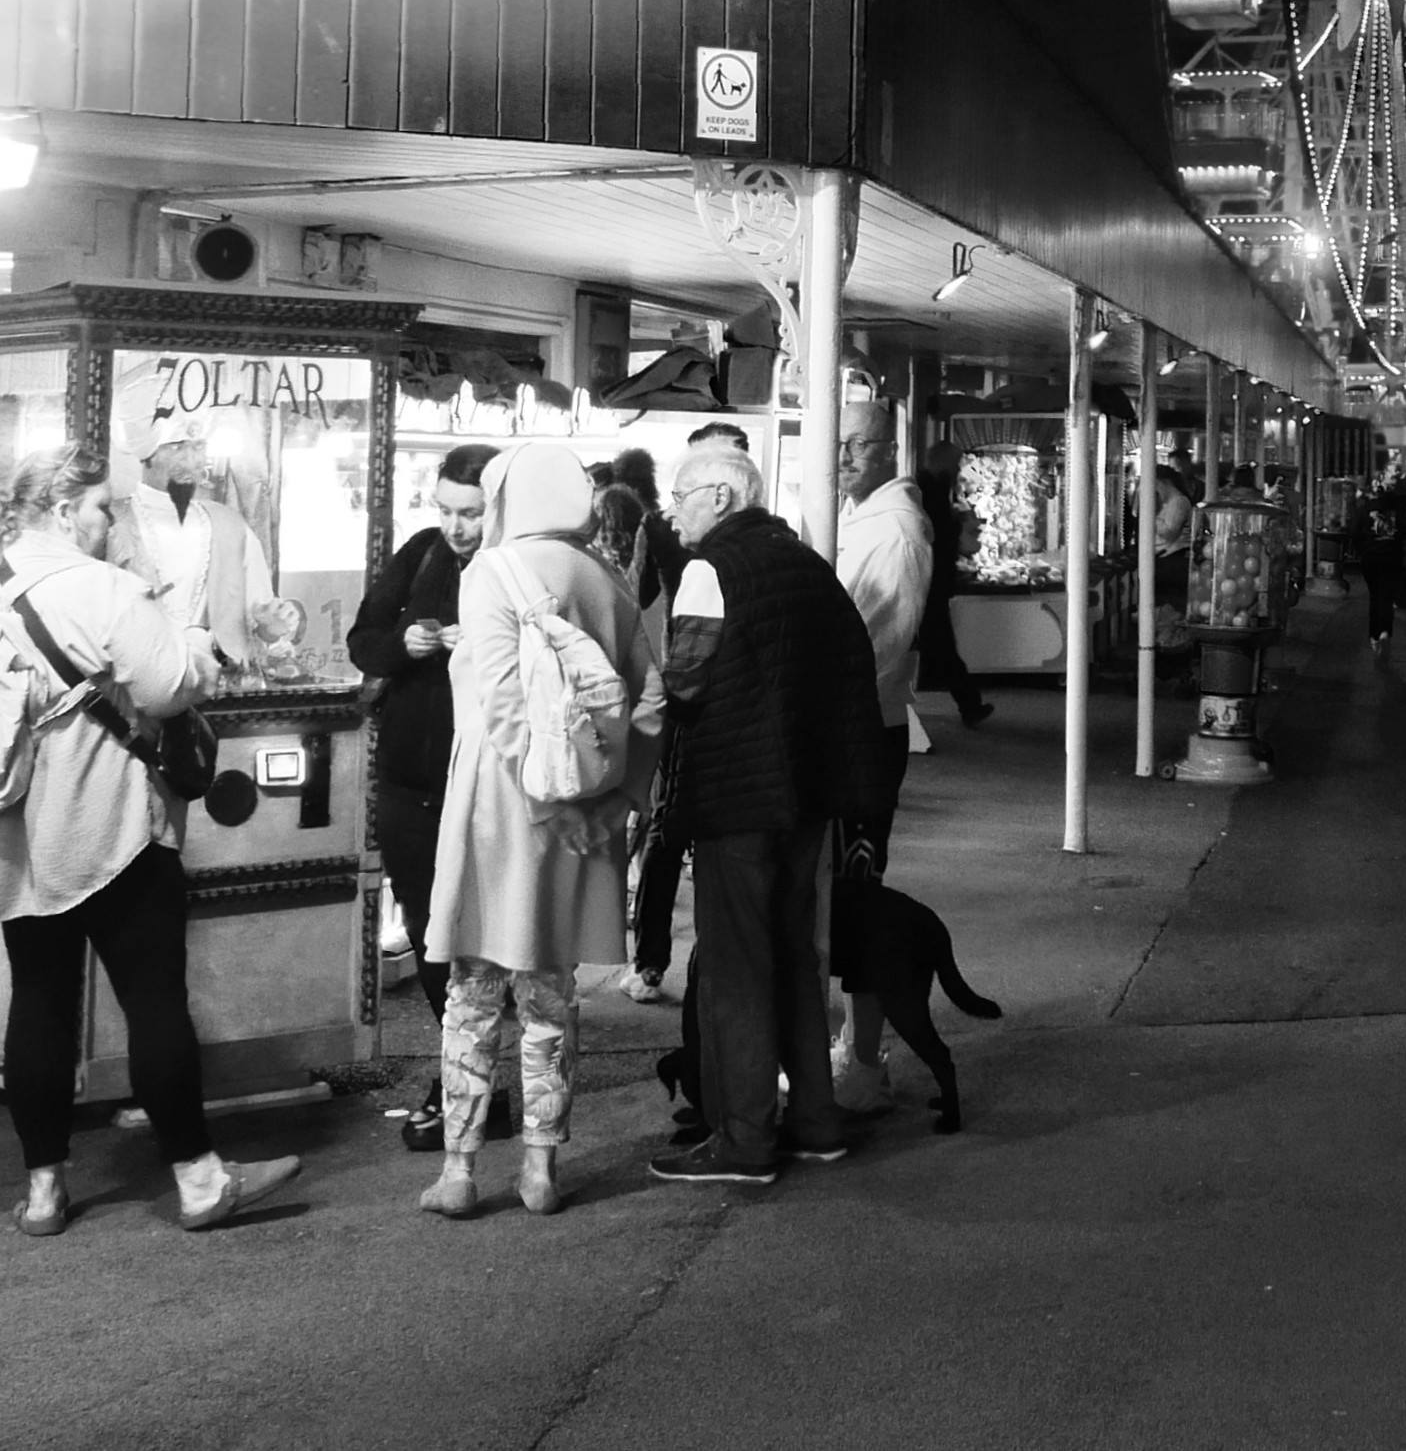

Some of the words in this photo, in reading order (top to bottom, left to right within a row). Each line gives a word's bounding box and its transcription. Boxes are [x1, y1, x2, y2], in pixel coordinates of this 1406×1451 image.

[706, 116, 726, 124] KEEP
[721, 126, 746, 135] LEADS
[151, 357, 331, 429] ZOLTAR
